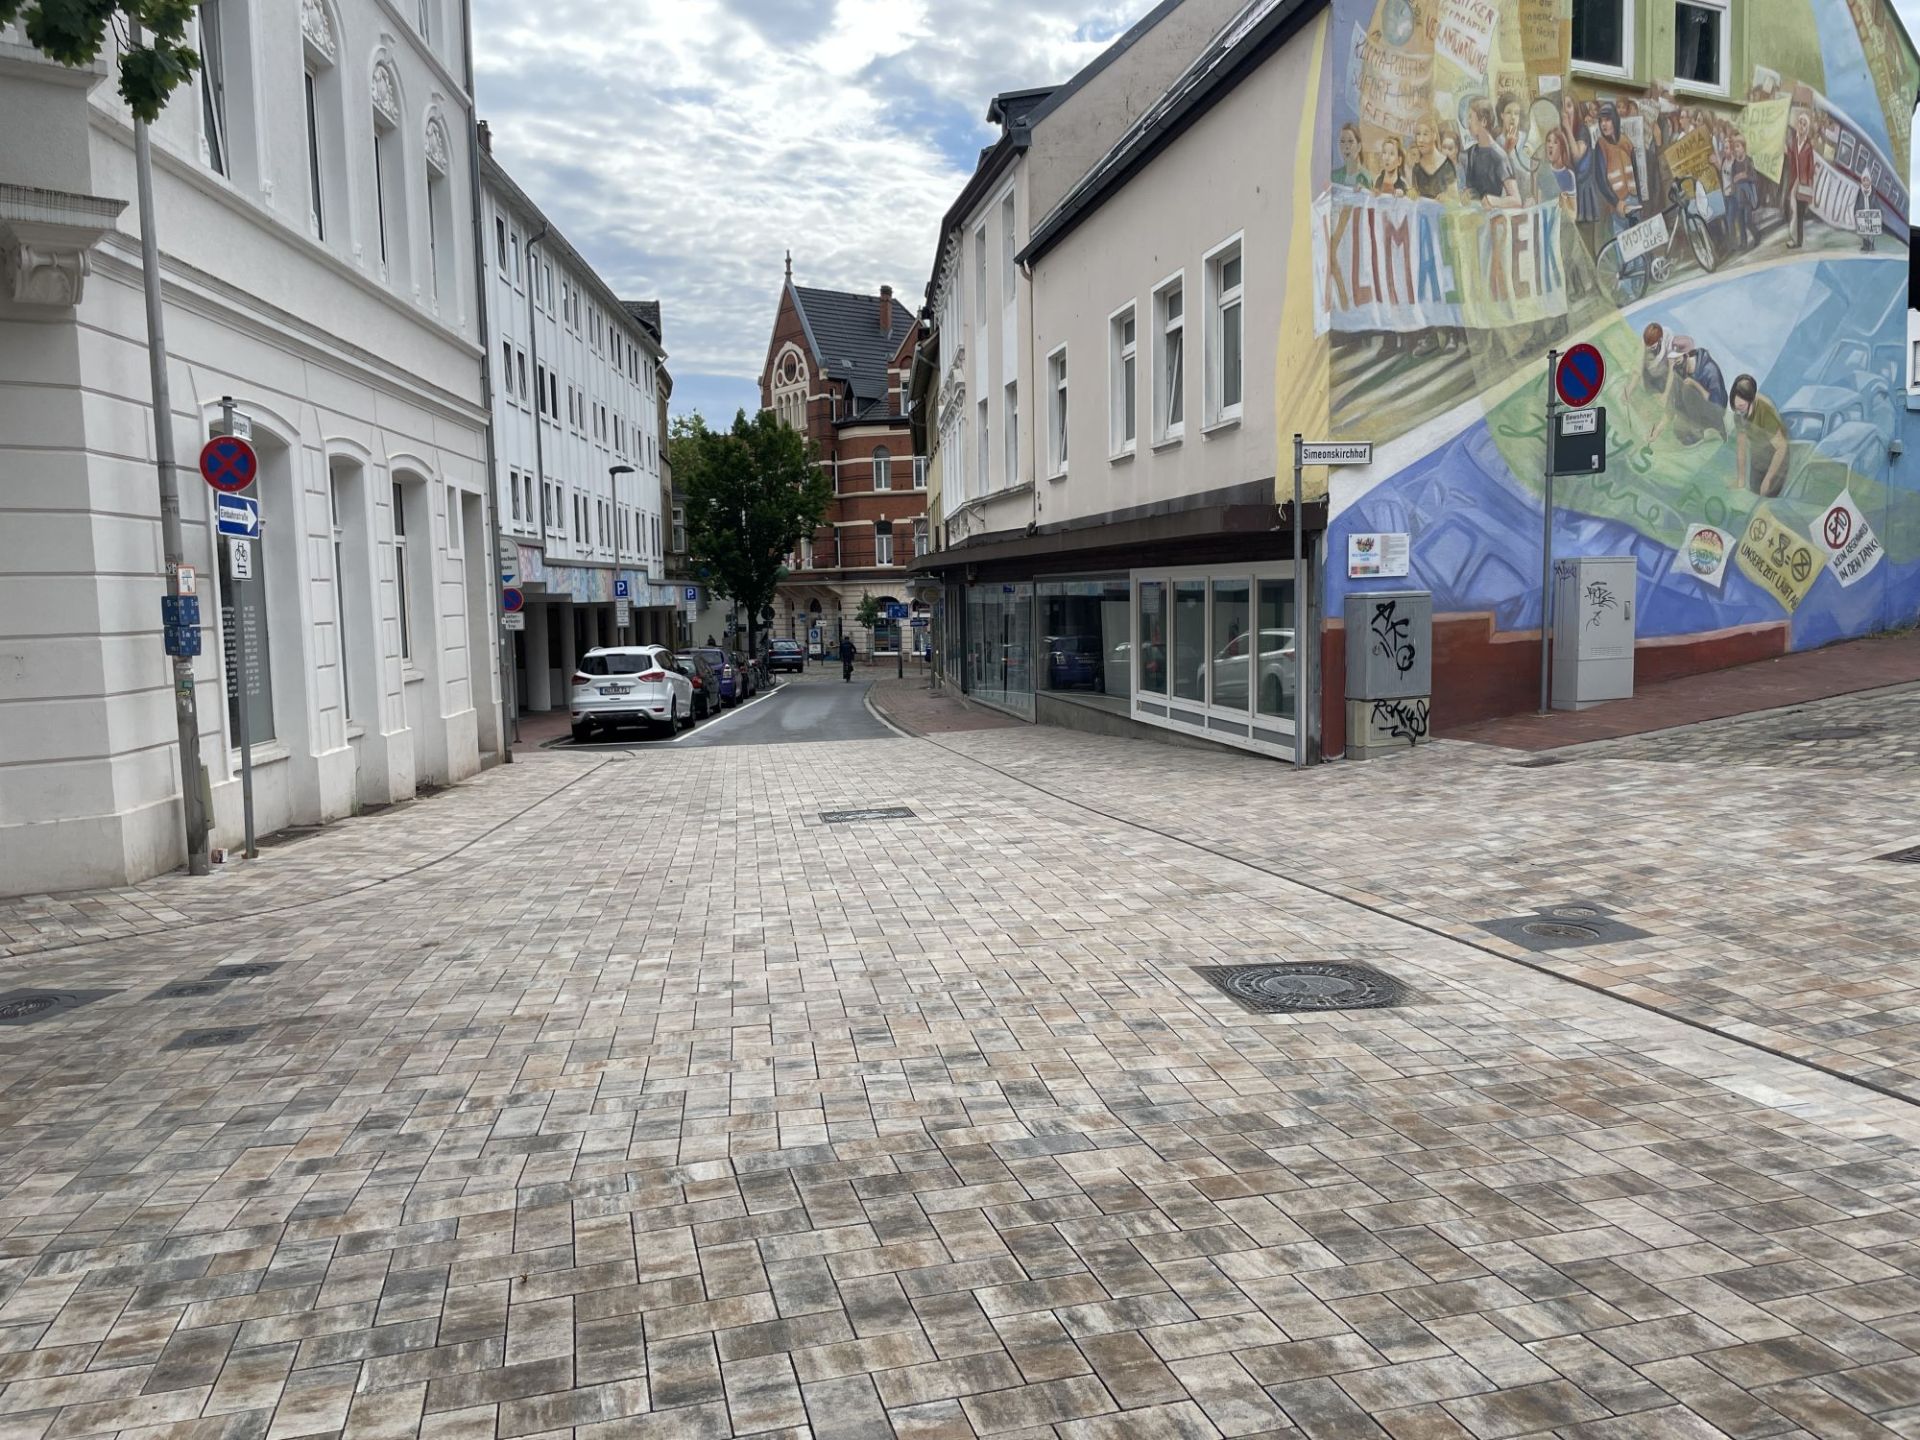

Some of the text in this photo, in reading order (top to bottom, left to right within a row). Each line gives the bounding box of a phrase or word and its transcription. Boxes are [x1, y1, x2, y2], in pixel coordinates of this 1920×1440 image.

[1322, 203, 1564, 314] KLIMASTREIK
[1303, 448, 1367, 460] Simeonskirchhof
[1762, 562, 1779, 583] ZEIT
